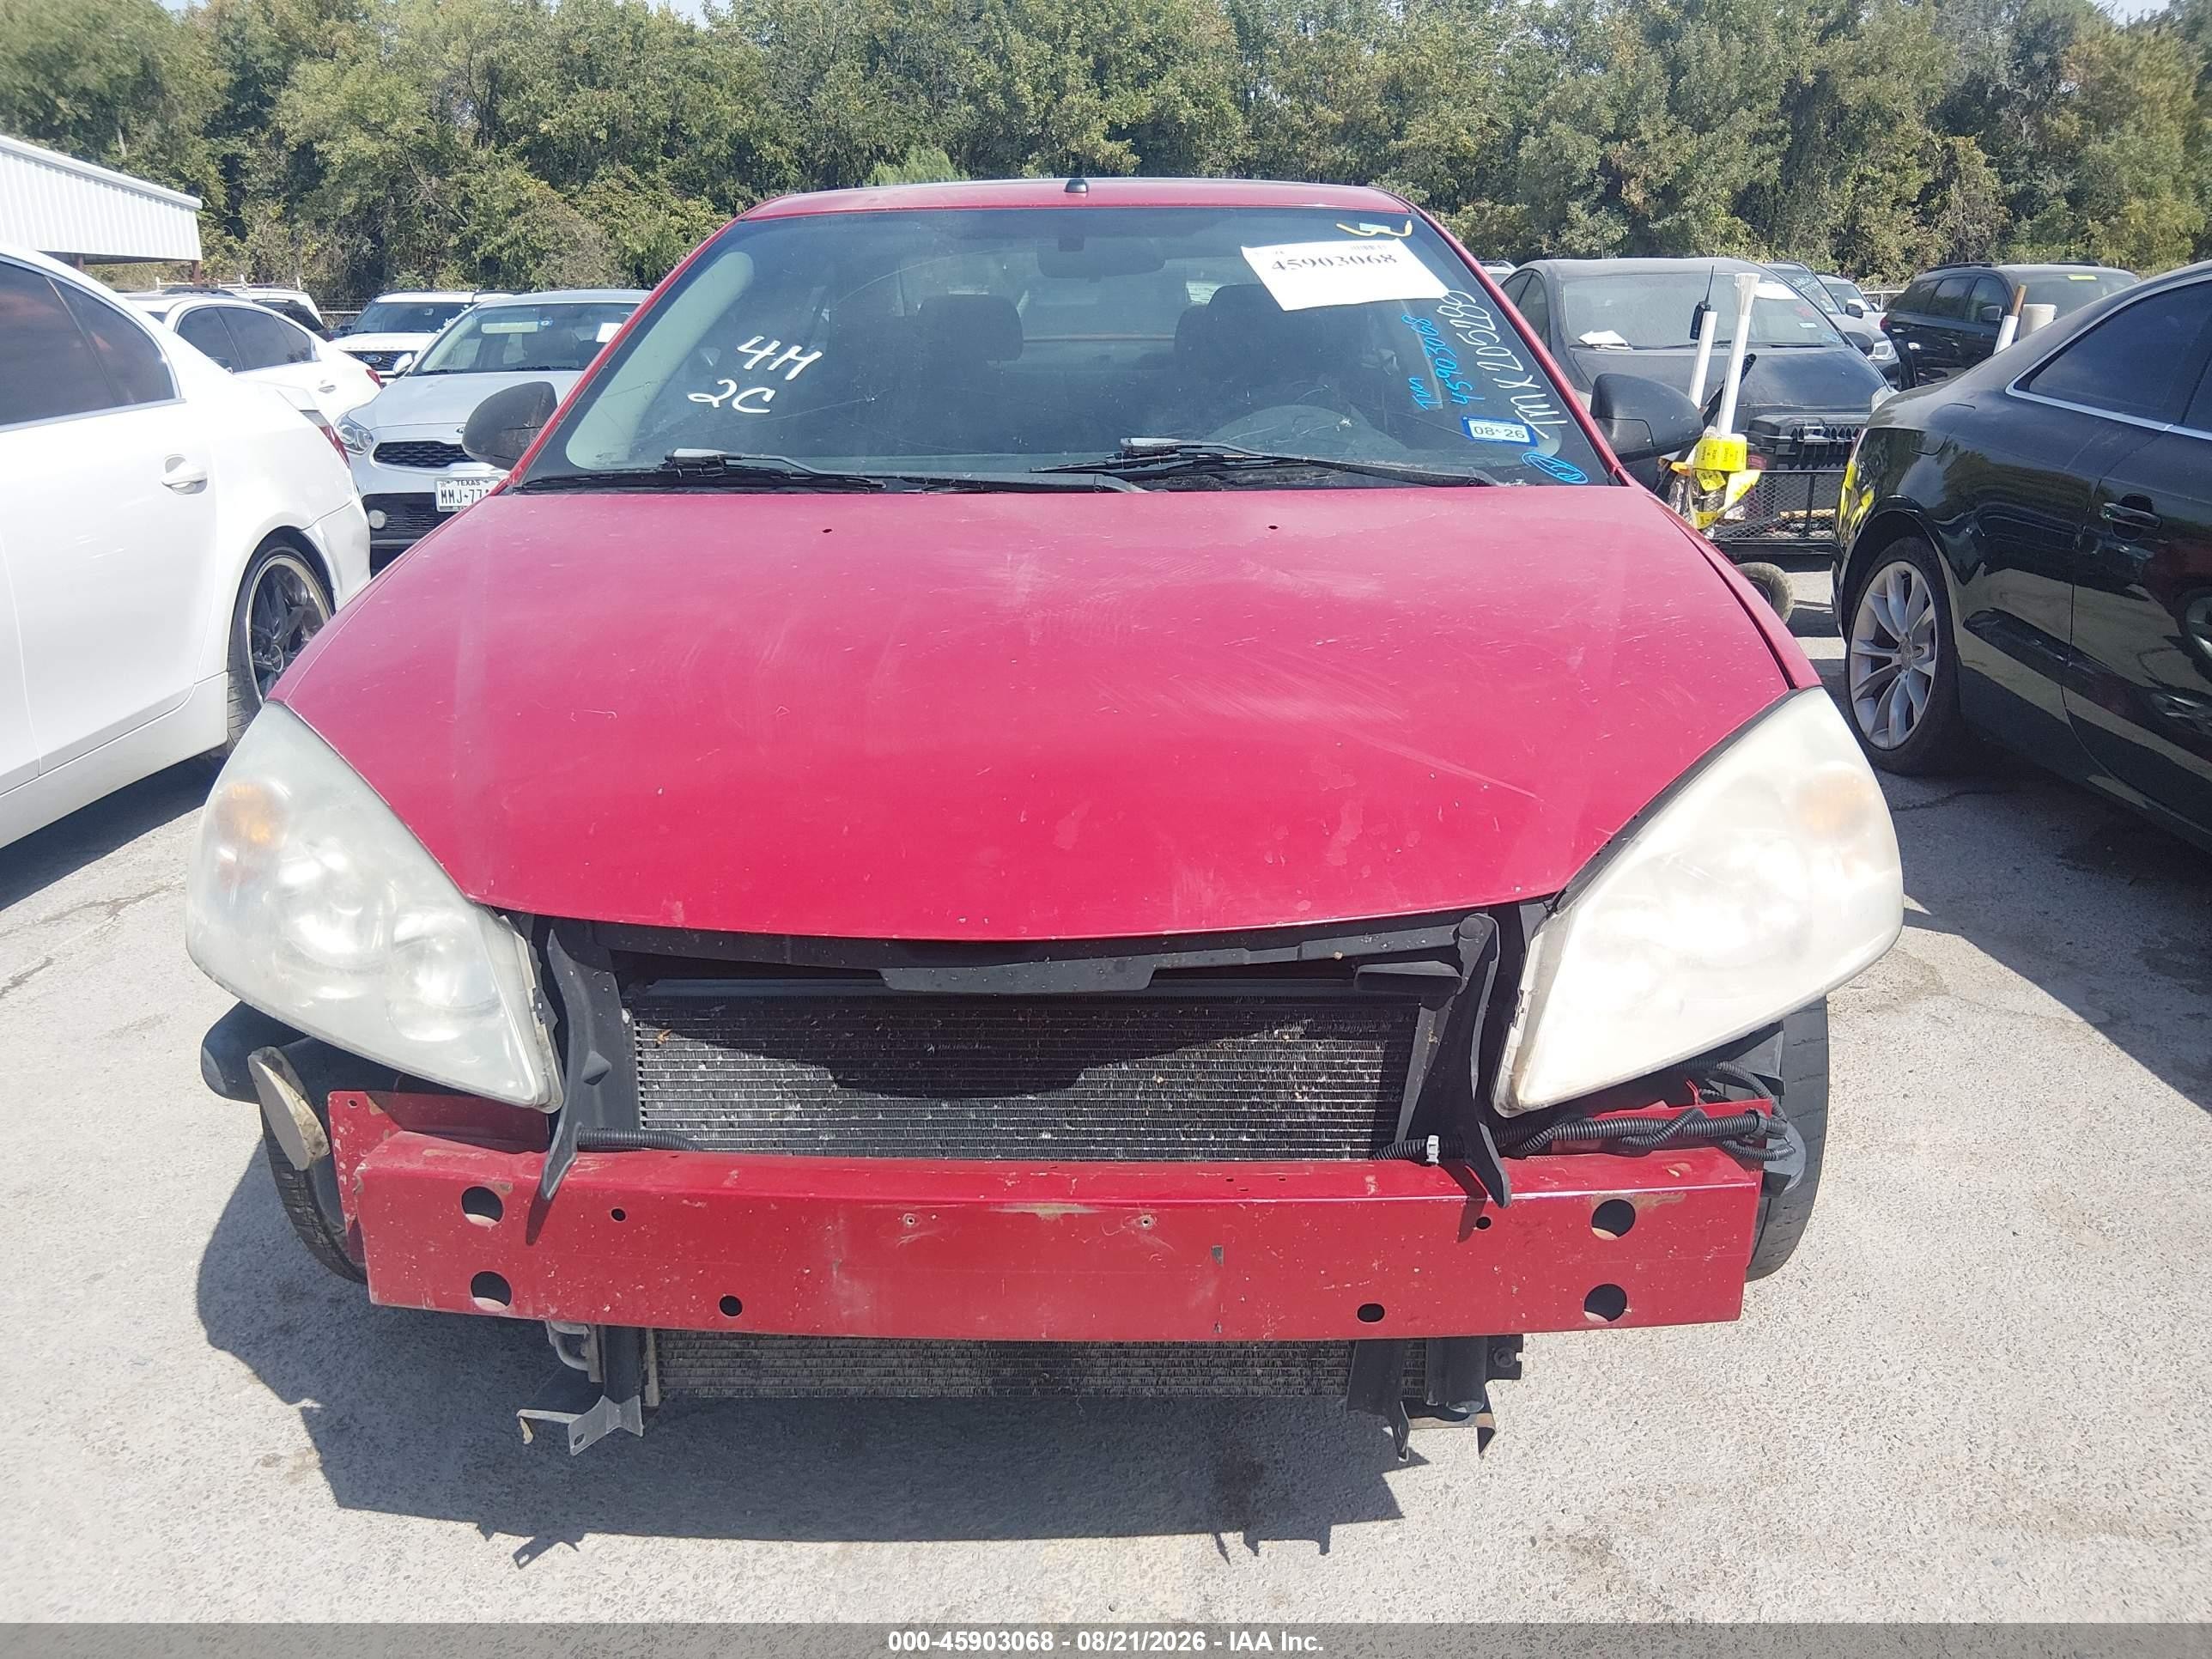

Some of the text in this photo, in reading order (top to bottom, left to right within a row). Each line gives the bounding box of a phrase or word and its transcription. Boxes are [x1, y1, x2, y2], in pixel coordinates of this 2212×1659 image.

[1272, 253, 1398, 271] 45903068
[1401, 313, 1486, 406] 45903068
[687, 379, 776, 413] 2C
